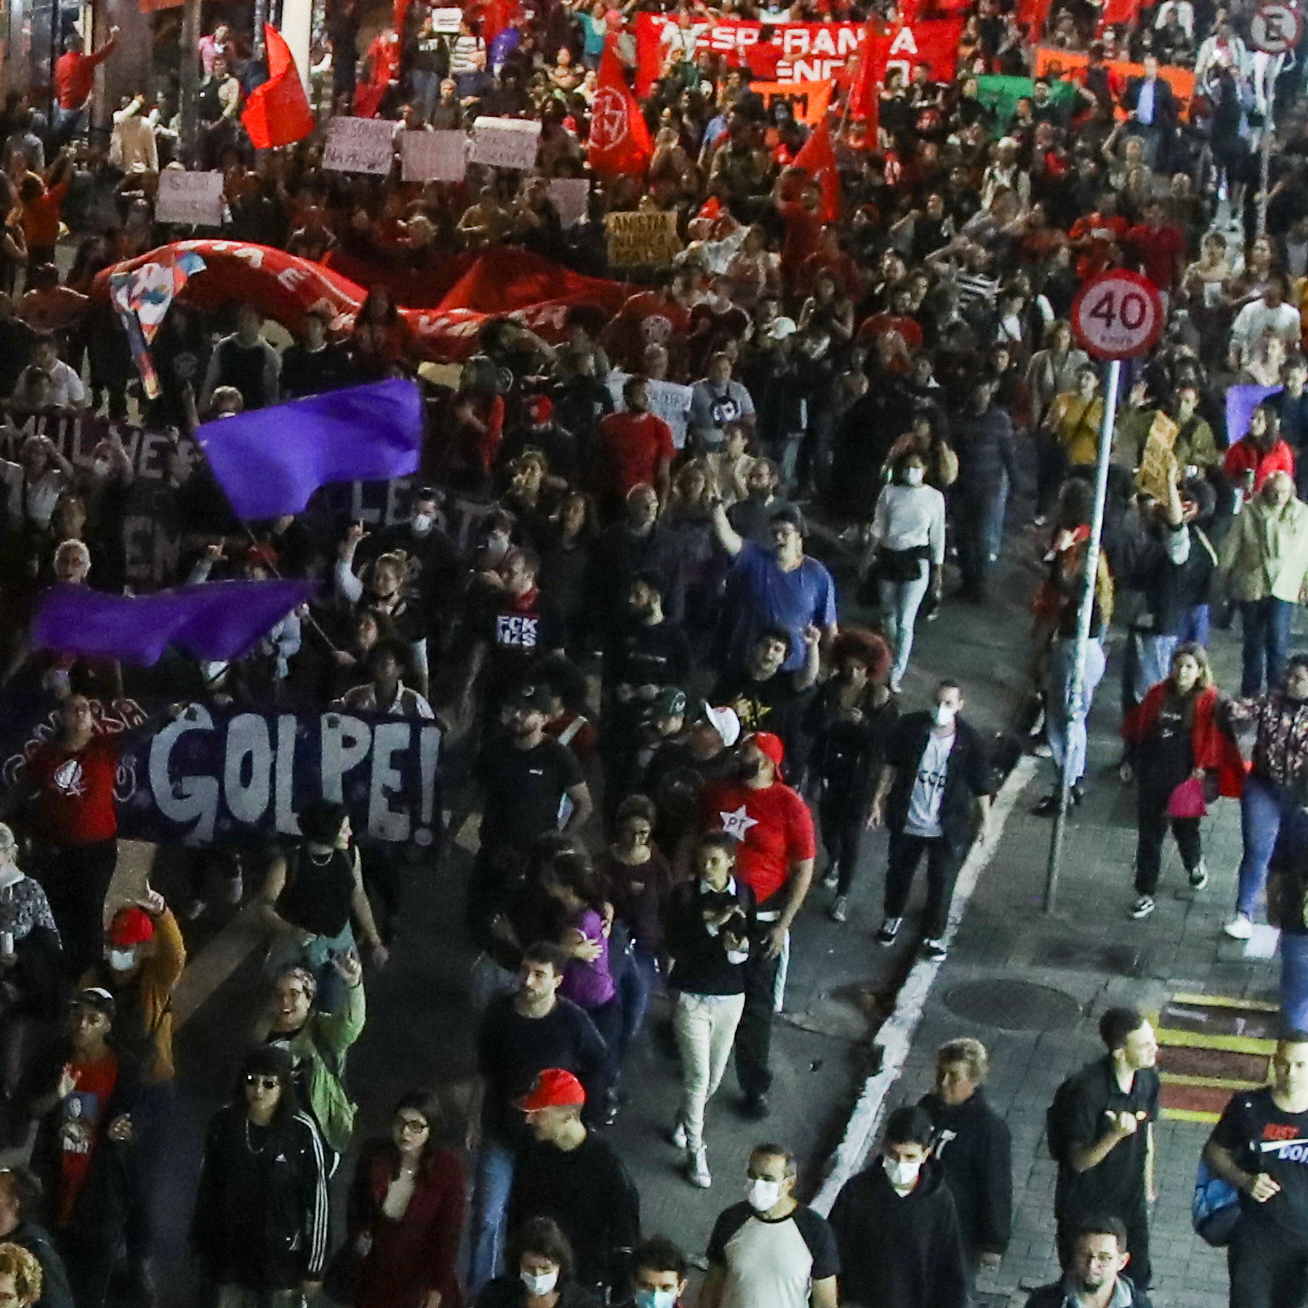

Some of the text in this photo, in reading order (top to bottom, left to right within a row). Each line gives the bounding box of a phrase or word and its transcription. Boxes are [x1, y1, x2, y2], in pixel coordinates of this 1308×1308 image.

[1089, 291, 1147, 330] 40
[497, 615, 538, 634] FCK
[148, 701, 443, 847] GOLPE!
[727, 816, 746, 831] PT
